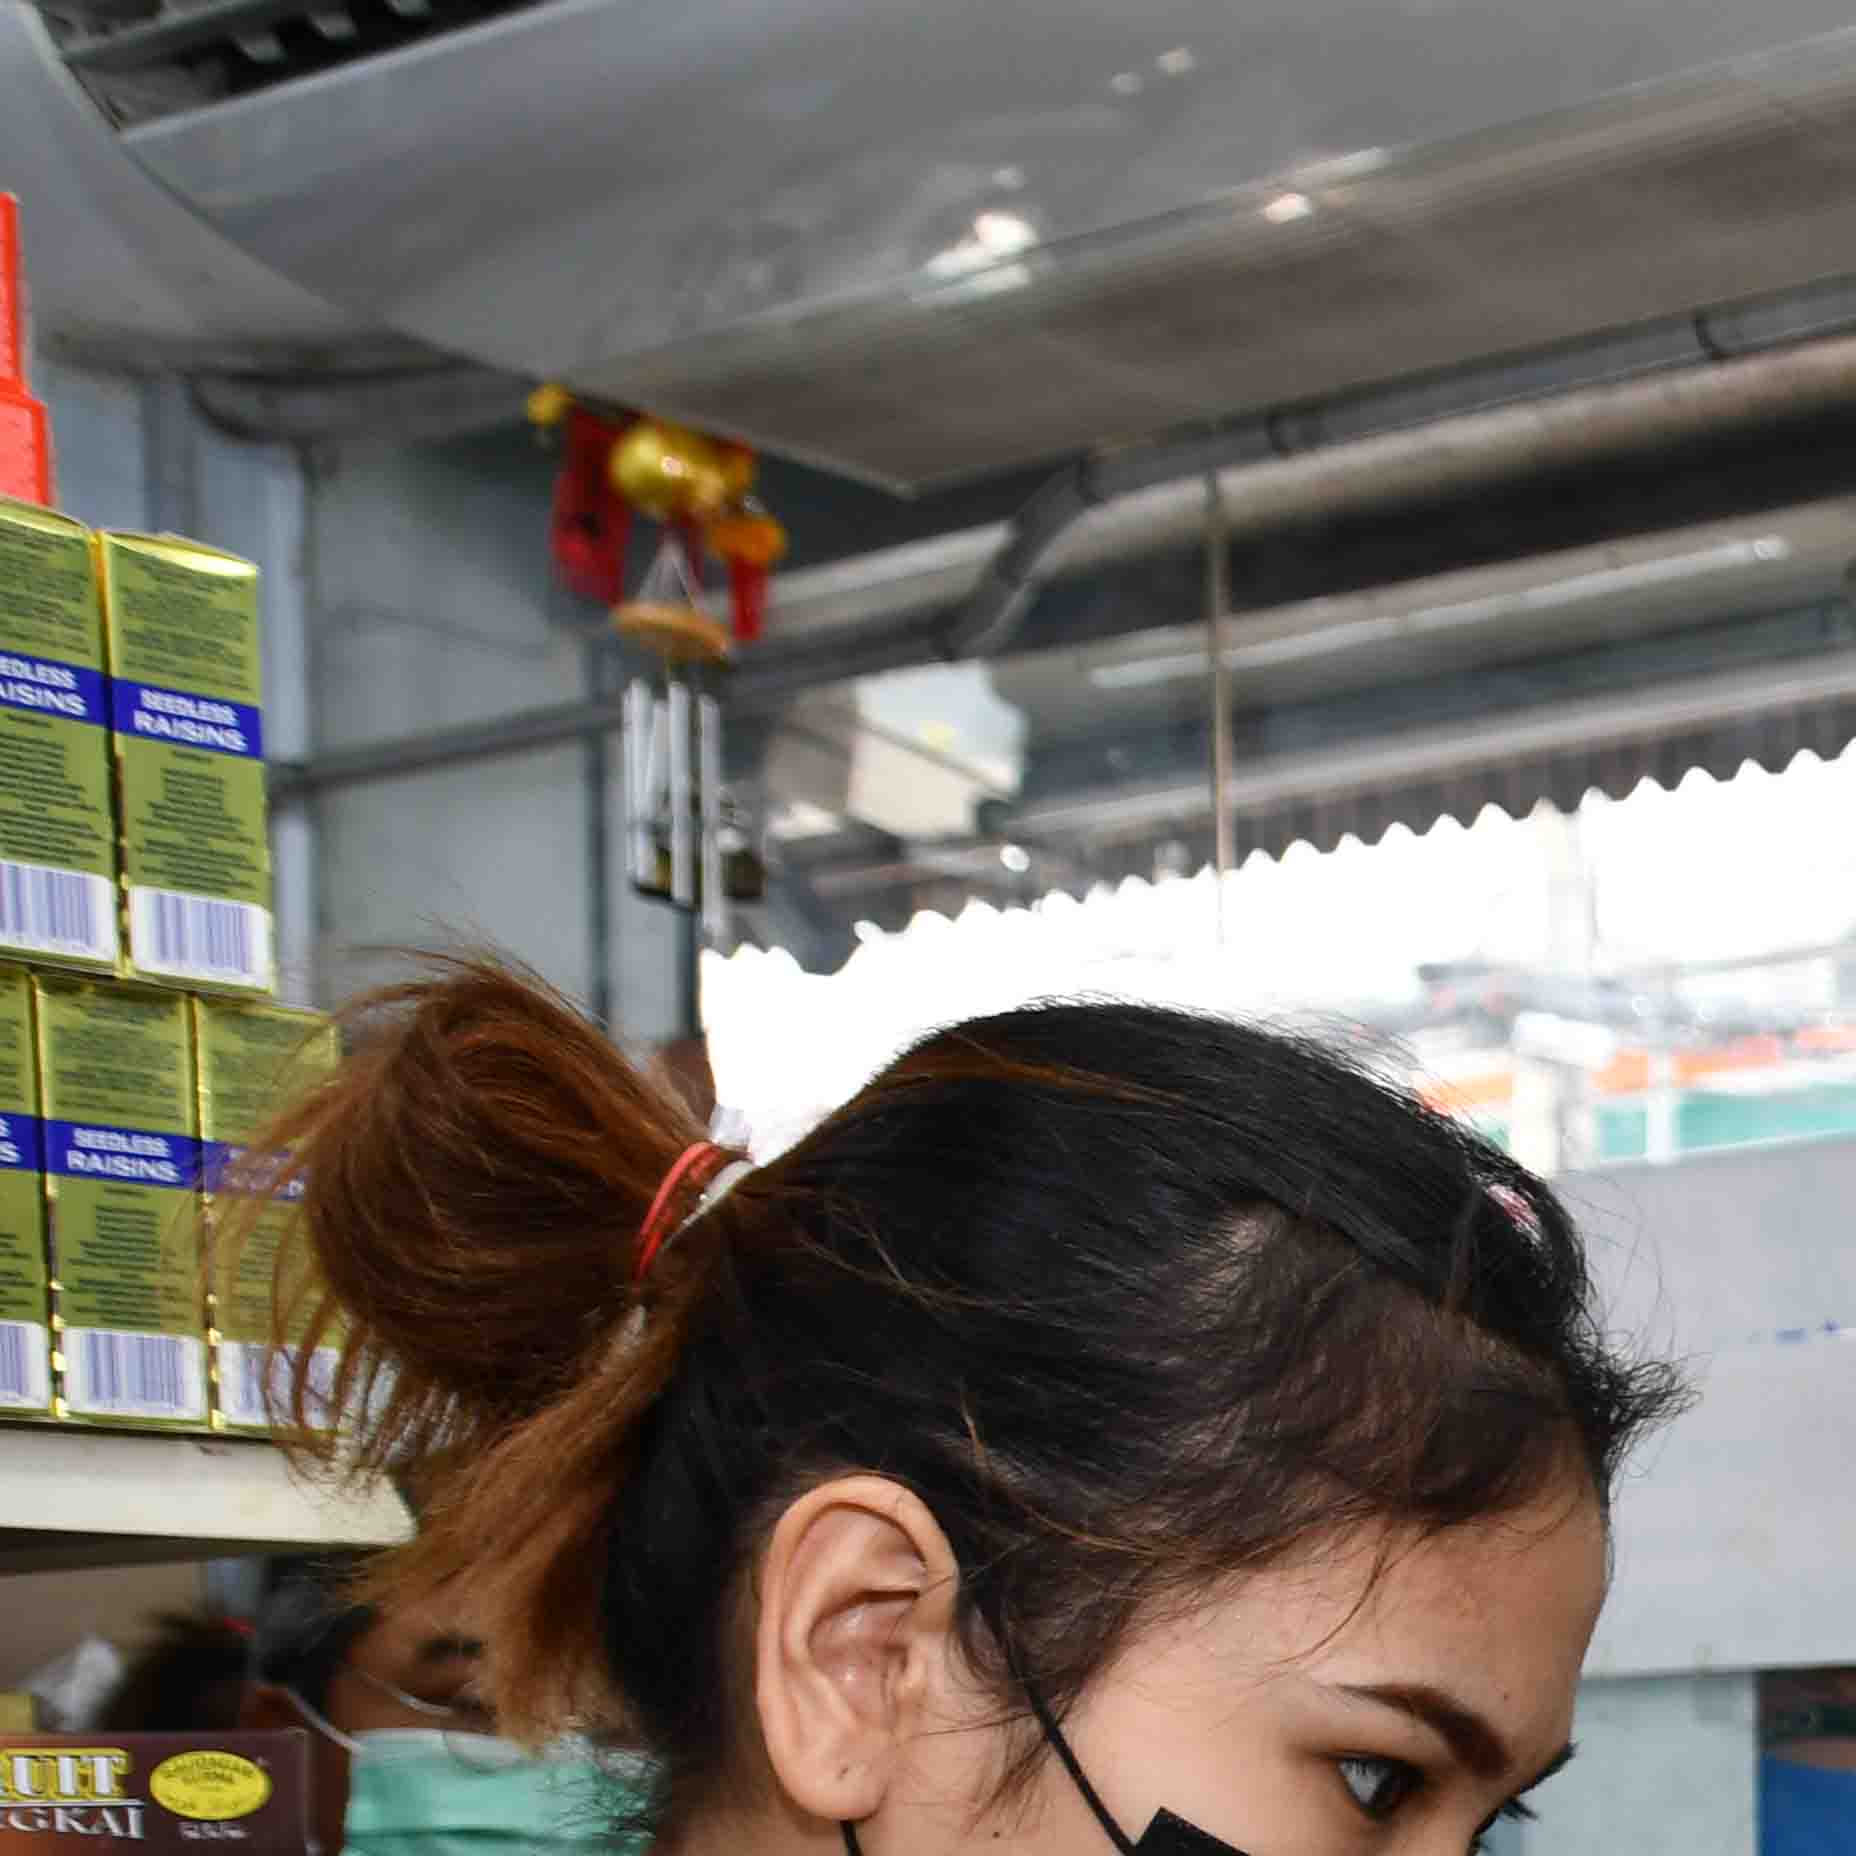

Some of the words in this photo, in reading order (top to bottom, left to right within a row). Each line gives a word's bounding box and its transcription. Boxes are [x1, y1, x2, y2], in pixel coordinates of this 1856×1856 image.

[140, 688, 238, 724] SEEDLESS
[133, 710, 247, 752] RAISINS
[66, 1150, 178, 1182] RAISINS
